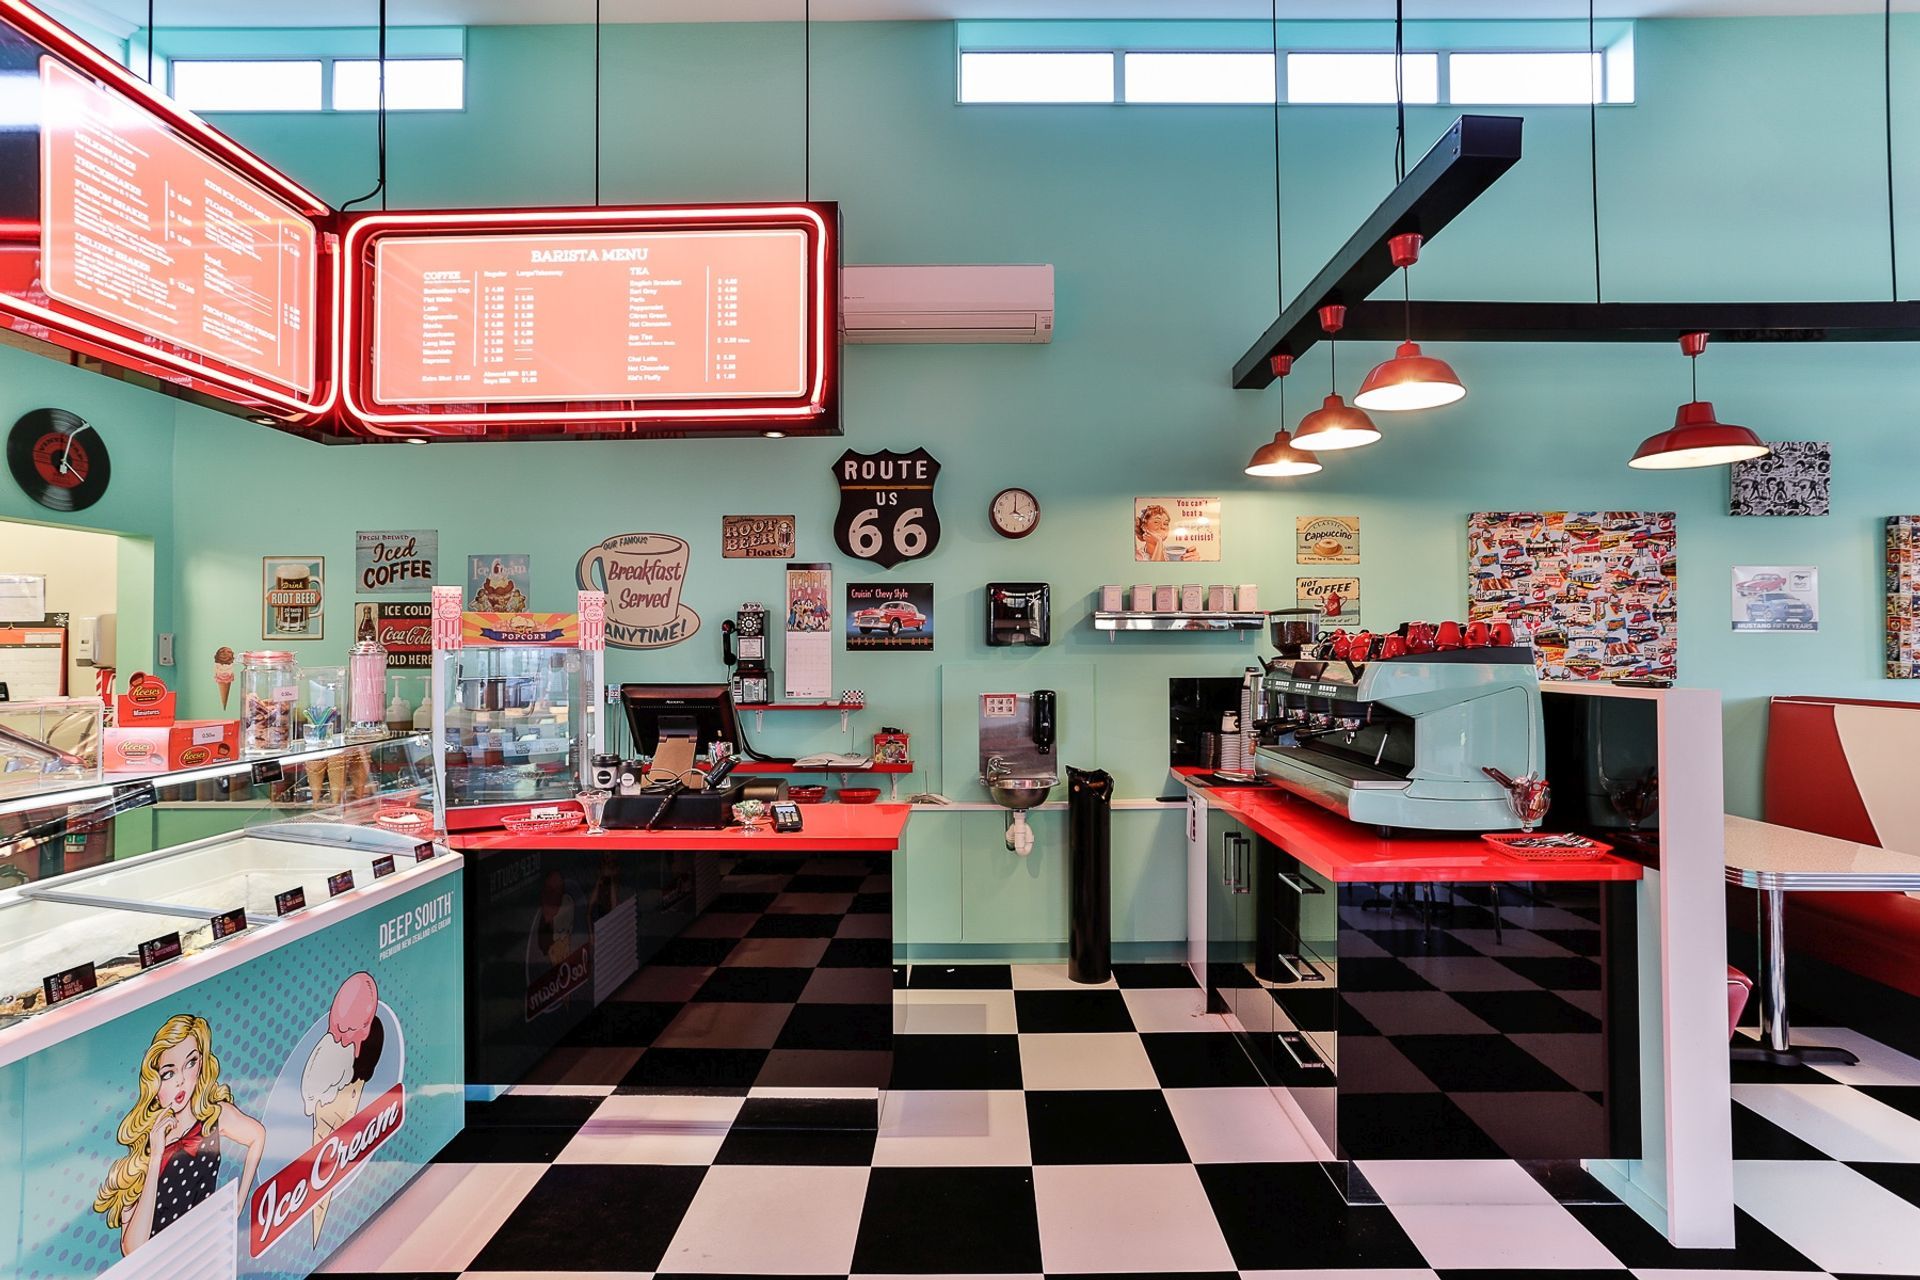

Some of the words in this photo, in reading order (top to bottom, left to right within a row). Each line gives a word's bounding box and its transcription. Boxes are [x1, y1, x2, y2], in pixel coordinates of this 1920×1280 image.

[531, 249, 598, 263] BARISTA
[602, 247, 649, 261] MENU
[423, 271, 461, 280] COFFEE
[629, 267, 650, 276] TEA
[844, 460, 927, 480] ROUTE
[876, 491, 898, 506] US
[725, 519, 777, 538] ROOT
[848, 507, 928, 558] 66
[1304, 529, 1352, 541] Cappuccino
[602, 540, 618, 550] OUR
[619, 536, 648, 547] FAMOUS
[726, 532, 775, 551] BEER
[1190, 532, 1214, 541] crisis!
[373, 537, 418, 563] Iced
[745, 548, 787, 557] Floats!
[363, 559, 432, 589] COFFEE
[472, 558, 490, 580] Ice
[608, 559, 682, 585] Breakfast
[282, 581, 304, 589] Drink
[1301, 580, 1318, 588] HOT
[1306, 582, 1352, 596] COFFEE
[271, 592, 294, 604] ROOT
[295, 592, 316, 604] BEER
[618, 586, 673, 610] Served
[851, 589, 873, 599] Cruisin'
[875, 588, 893, 600] Chevy
[894, 588, 909, 600] Style
[384, 605, 401, 616] ICE
[403, 605, 432, 616] COLD
[604, 618, 687, 643] ANYTIME!
[408, 654, 432, 665] HERE
[133, 709, 160, 717] Miniatures
[379, 911, 413, 949] DEEP
[414, 892, 451, 931] SOUTH
[379, 944, 401, 961] PREMIUM
[401, 938, 412, 950] NEW
[412, 928, 431, 944] ZEALAND
[257, 1179, 310, 1242] Ice
[310, 1100, 399, 1191] Cream
